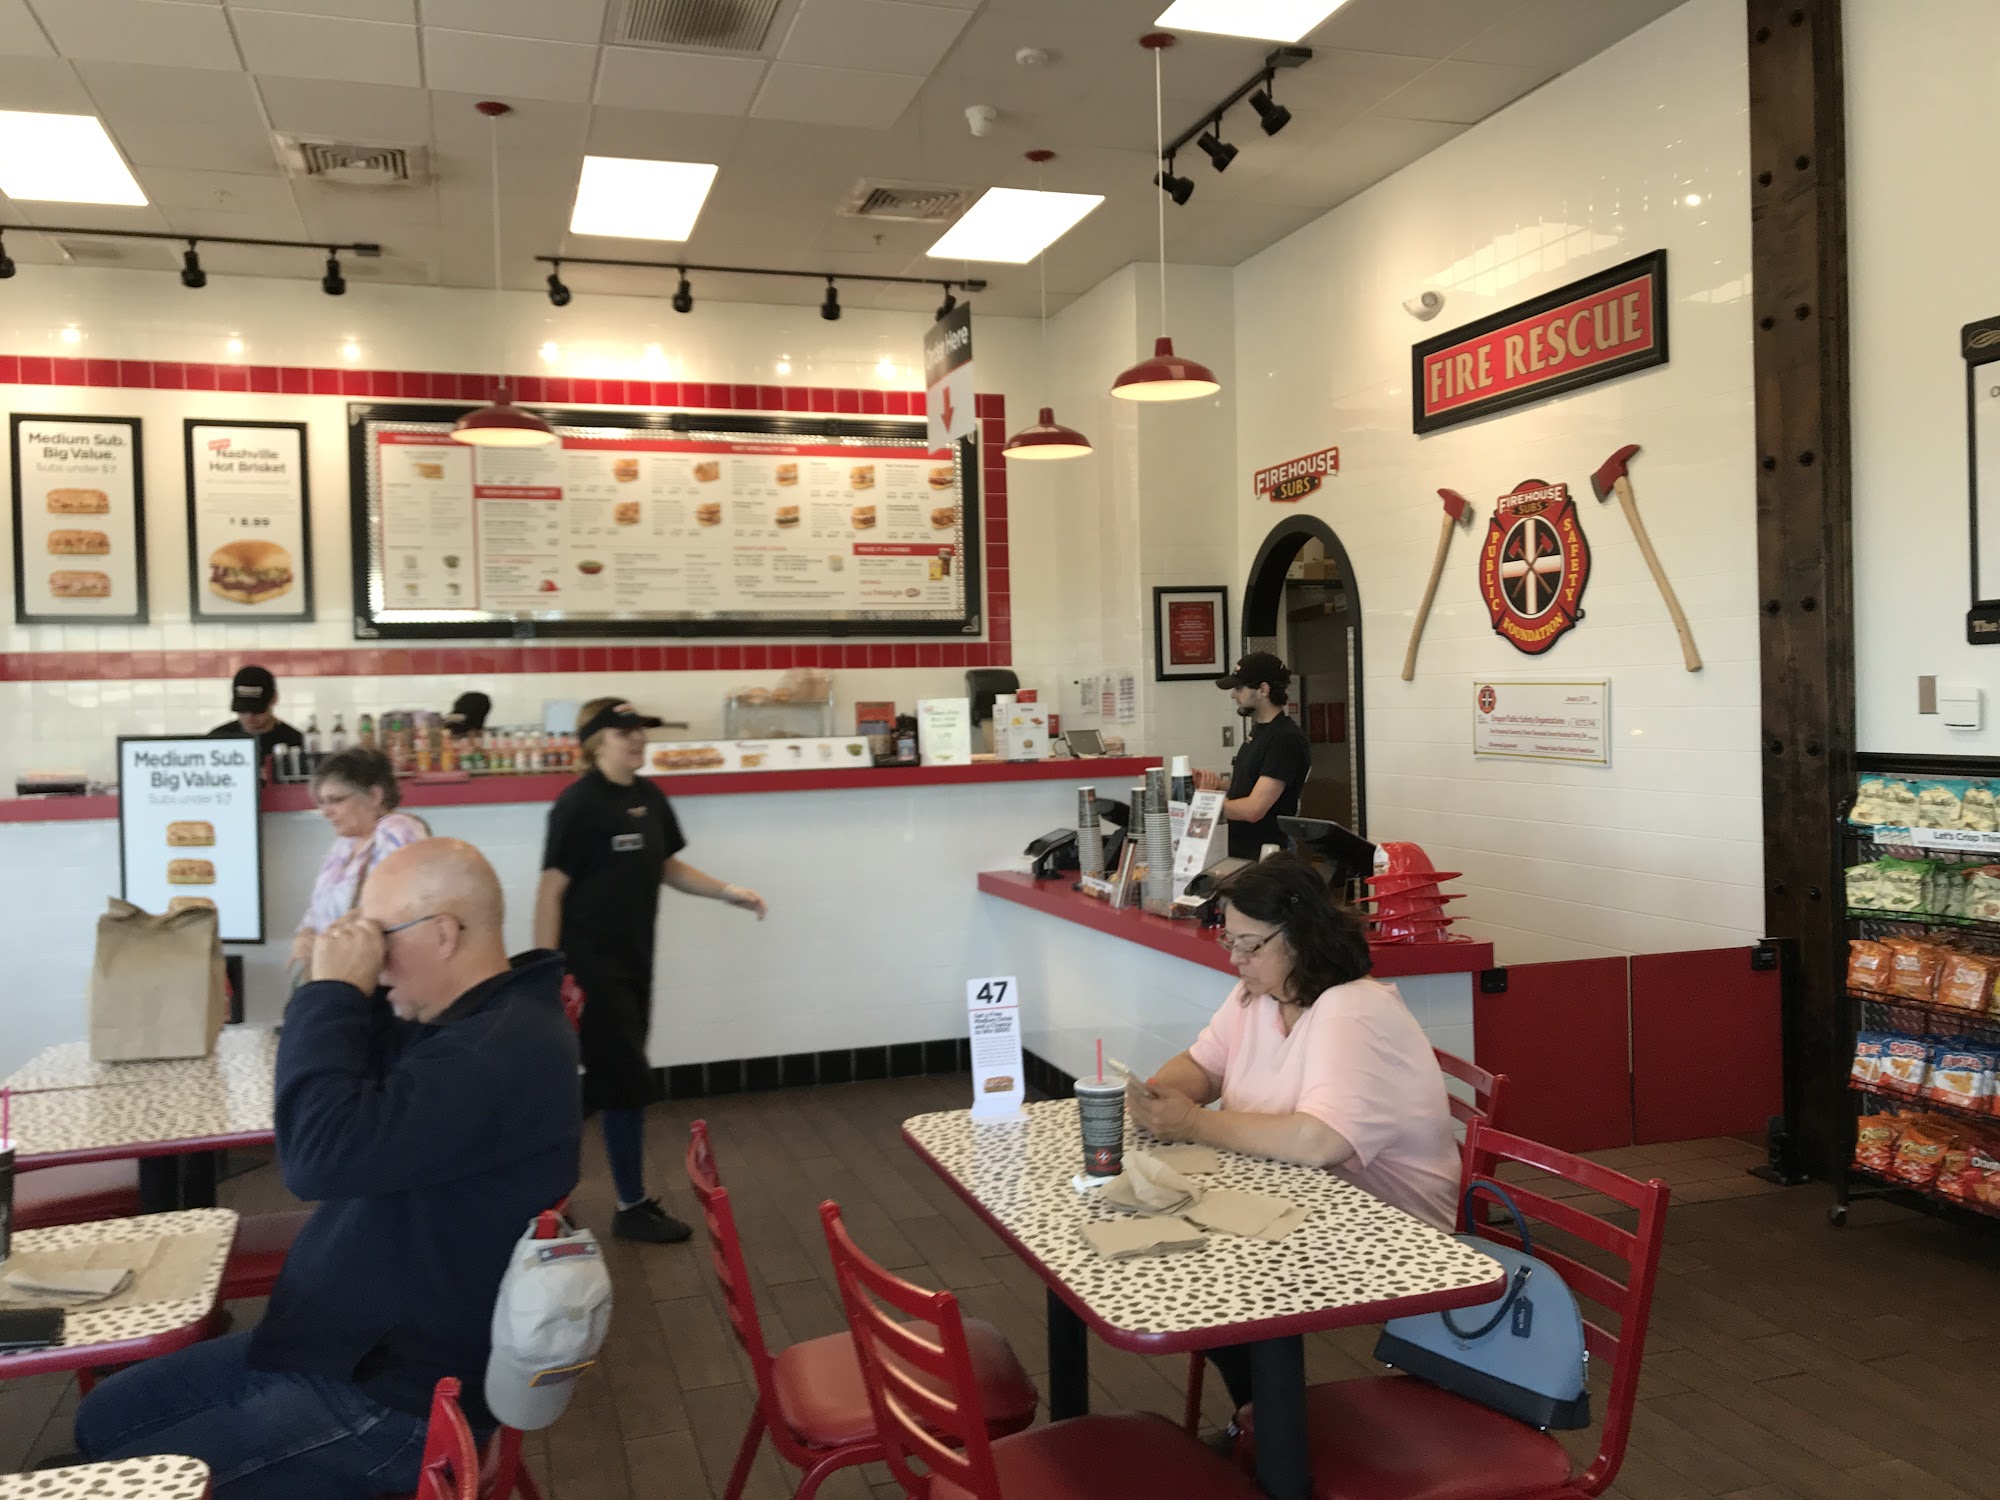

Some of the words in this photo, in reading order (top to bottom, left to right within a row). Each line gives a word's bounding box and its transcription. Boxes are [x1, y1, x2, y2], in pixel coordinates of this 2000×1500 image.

[944, 326, 969, 354] Here
[1430, 344, 1494, 404] FIRE
[1503, 291, 1644, 380] RESCUE
[28, 433, 90, 446] Medium
[43, 447, 68, 460] Big
[209, 461, 234, 472] Hot
[238, 461, 287, 473] Brisket
[1256, 449, 1337, 500] FIREHOUSE
[1281, 477, 1311, 499] SUBS
[1499, 486, 1563, 514] FIREHOUSE
[1518, 501, 1543, 514] SUBS
[1485, 531, 1500, 611] PUBLIC
[1563, 518, 1580, 601] SAFETY
[1502, 612, 1564, 642] FOUNDATION
[134, 750, 206, 768] Medium
[210, 749, 249, 767] Sub.
[151, 770, 180, 792] Big
[182, 770, 238, 788] Value.
[976, 981, 1008, 1004] 47
